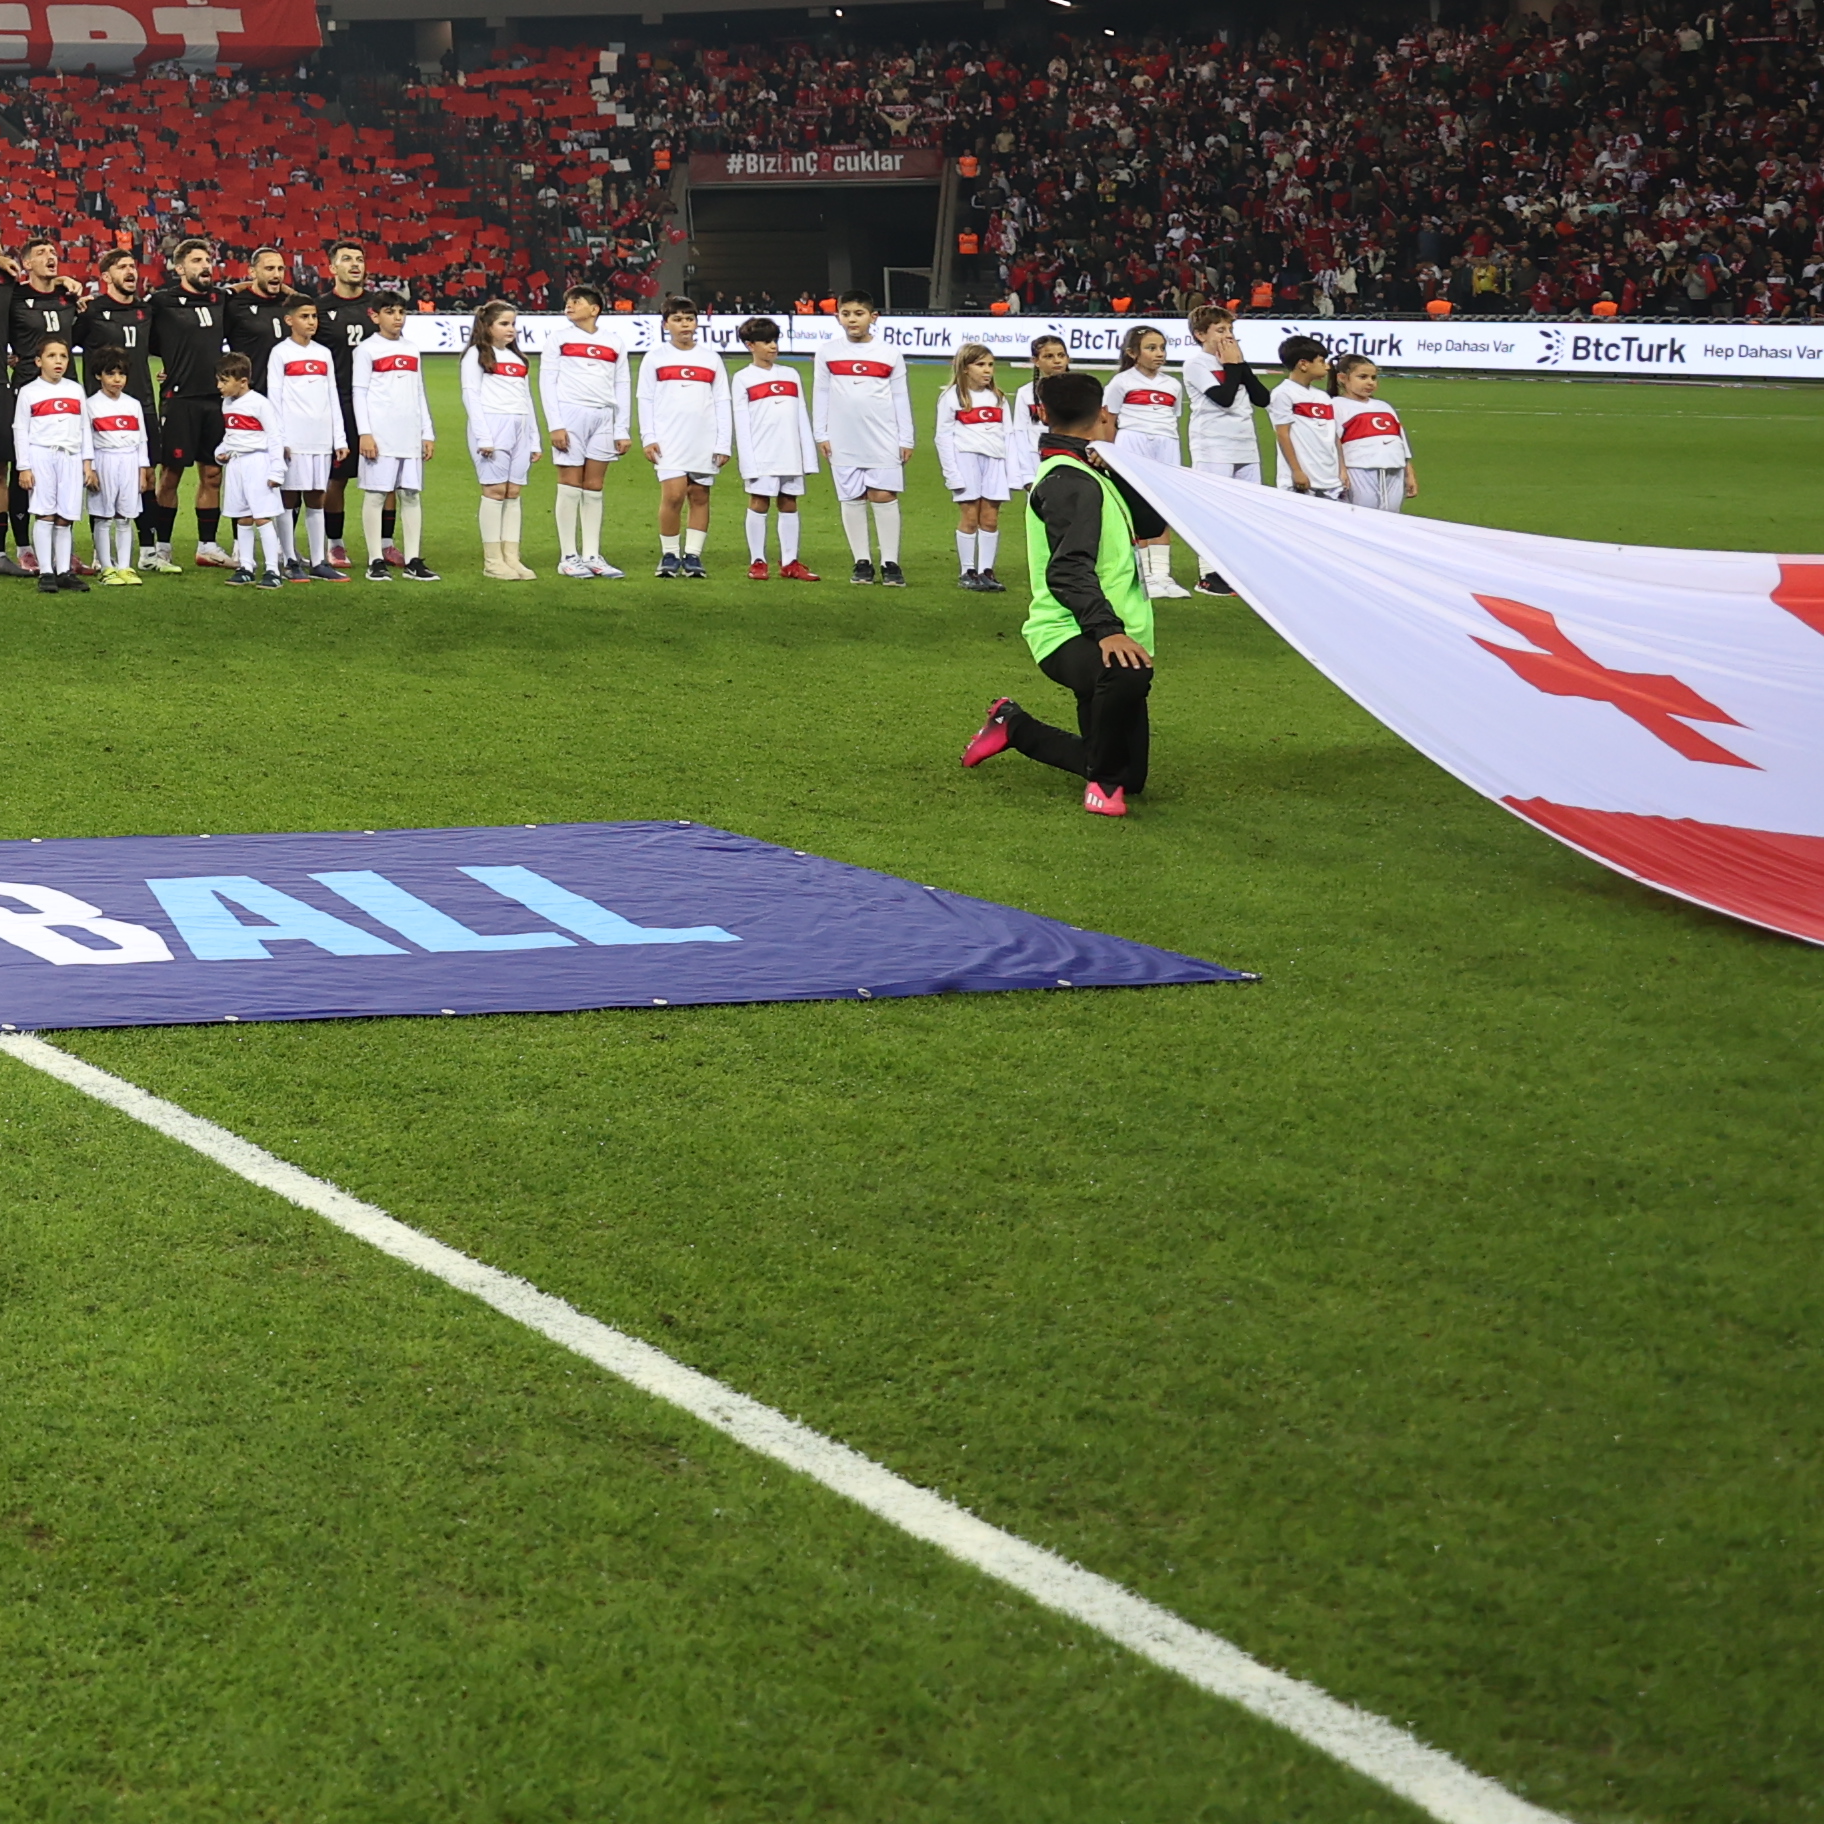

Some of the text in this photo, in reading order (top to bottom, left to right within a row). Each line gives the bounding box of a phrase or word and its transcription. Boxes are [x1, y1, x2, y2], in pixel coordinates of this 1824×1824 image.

[726, 151, 904, 176] #BizimÇcuklar
[42, 310, 60, 332] 13
[272, 317, 282, 339] 6
[123, 325, 137, 347] 17
[346, 324, 364, 346] 22
[884, 328, 1031, 347] BtcTurk Hep Dahası Var
[1070, 329, 1121, 350] BtcTu
[1417, 339, 1442, 354] Hep
[1446, 339, 1490, 353] Dahası
[1493, 341, 1515, 353] Var
[1572, 336, 1823, 363] BtcTurk Hep Dahası Var
